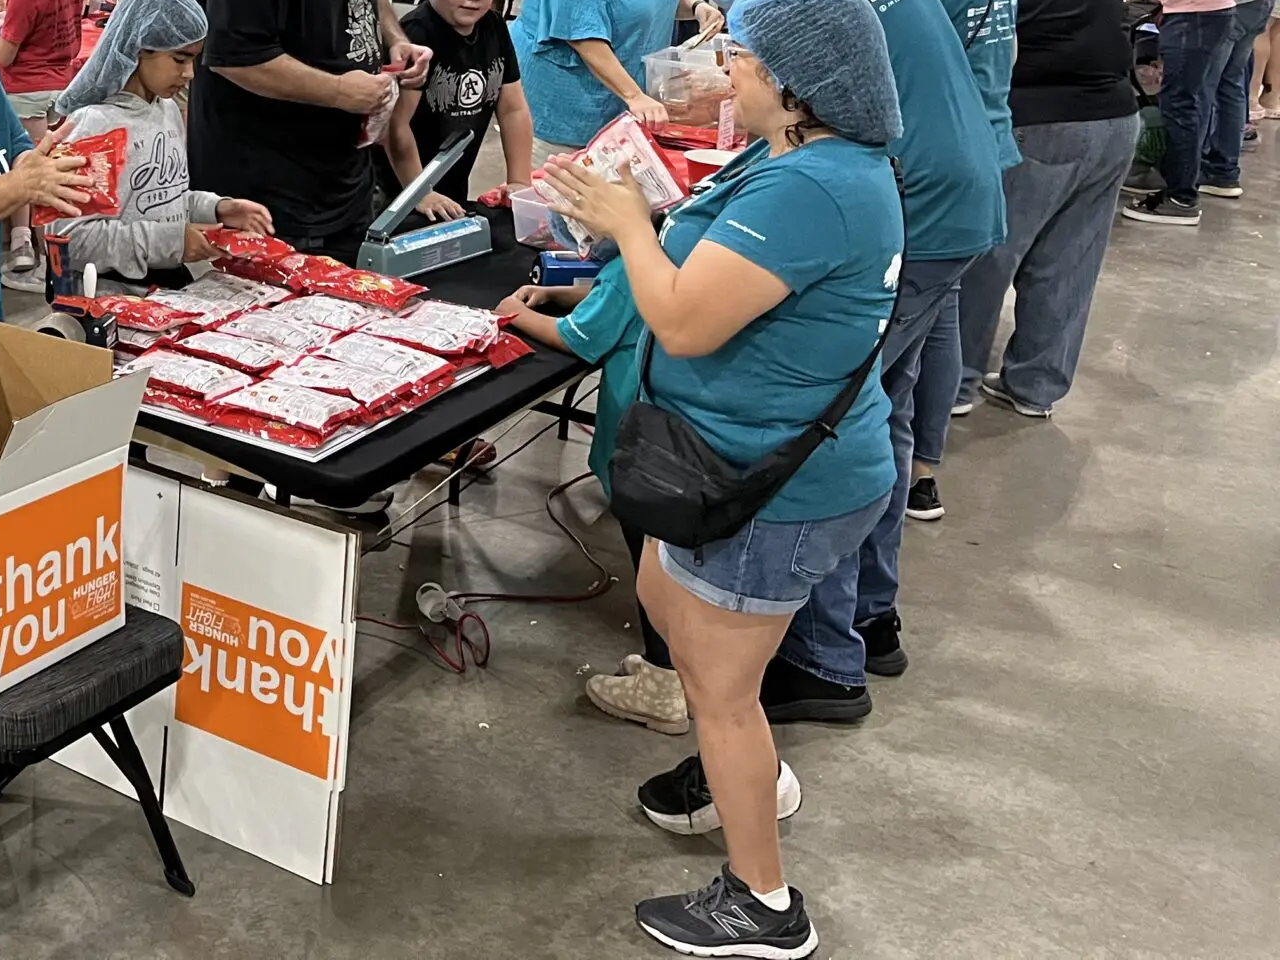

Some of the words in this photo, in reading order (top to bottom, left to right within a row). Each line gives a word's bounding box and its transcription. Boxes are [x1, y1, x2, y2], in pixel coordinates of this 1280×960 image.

[73, 570, 116, 600] HUNGER
[86, 578, 119, 609] FIGHT
[185, 606, 225, 630] FIGHT
[188, 621, 239, 648] HUNGER
[247, 615, 340, 681] you
[182, 635, 339, 737] thank
